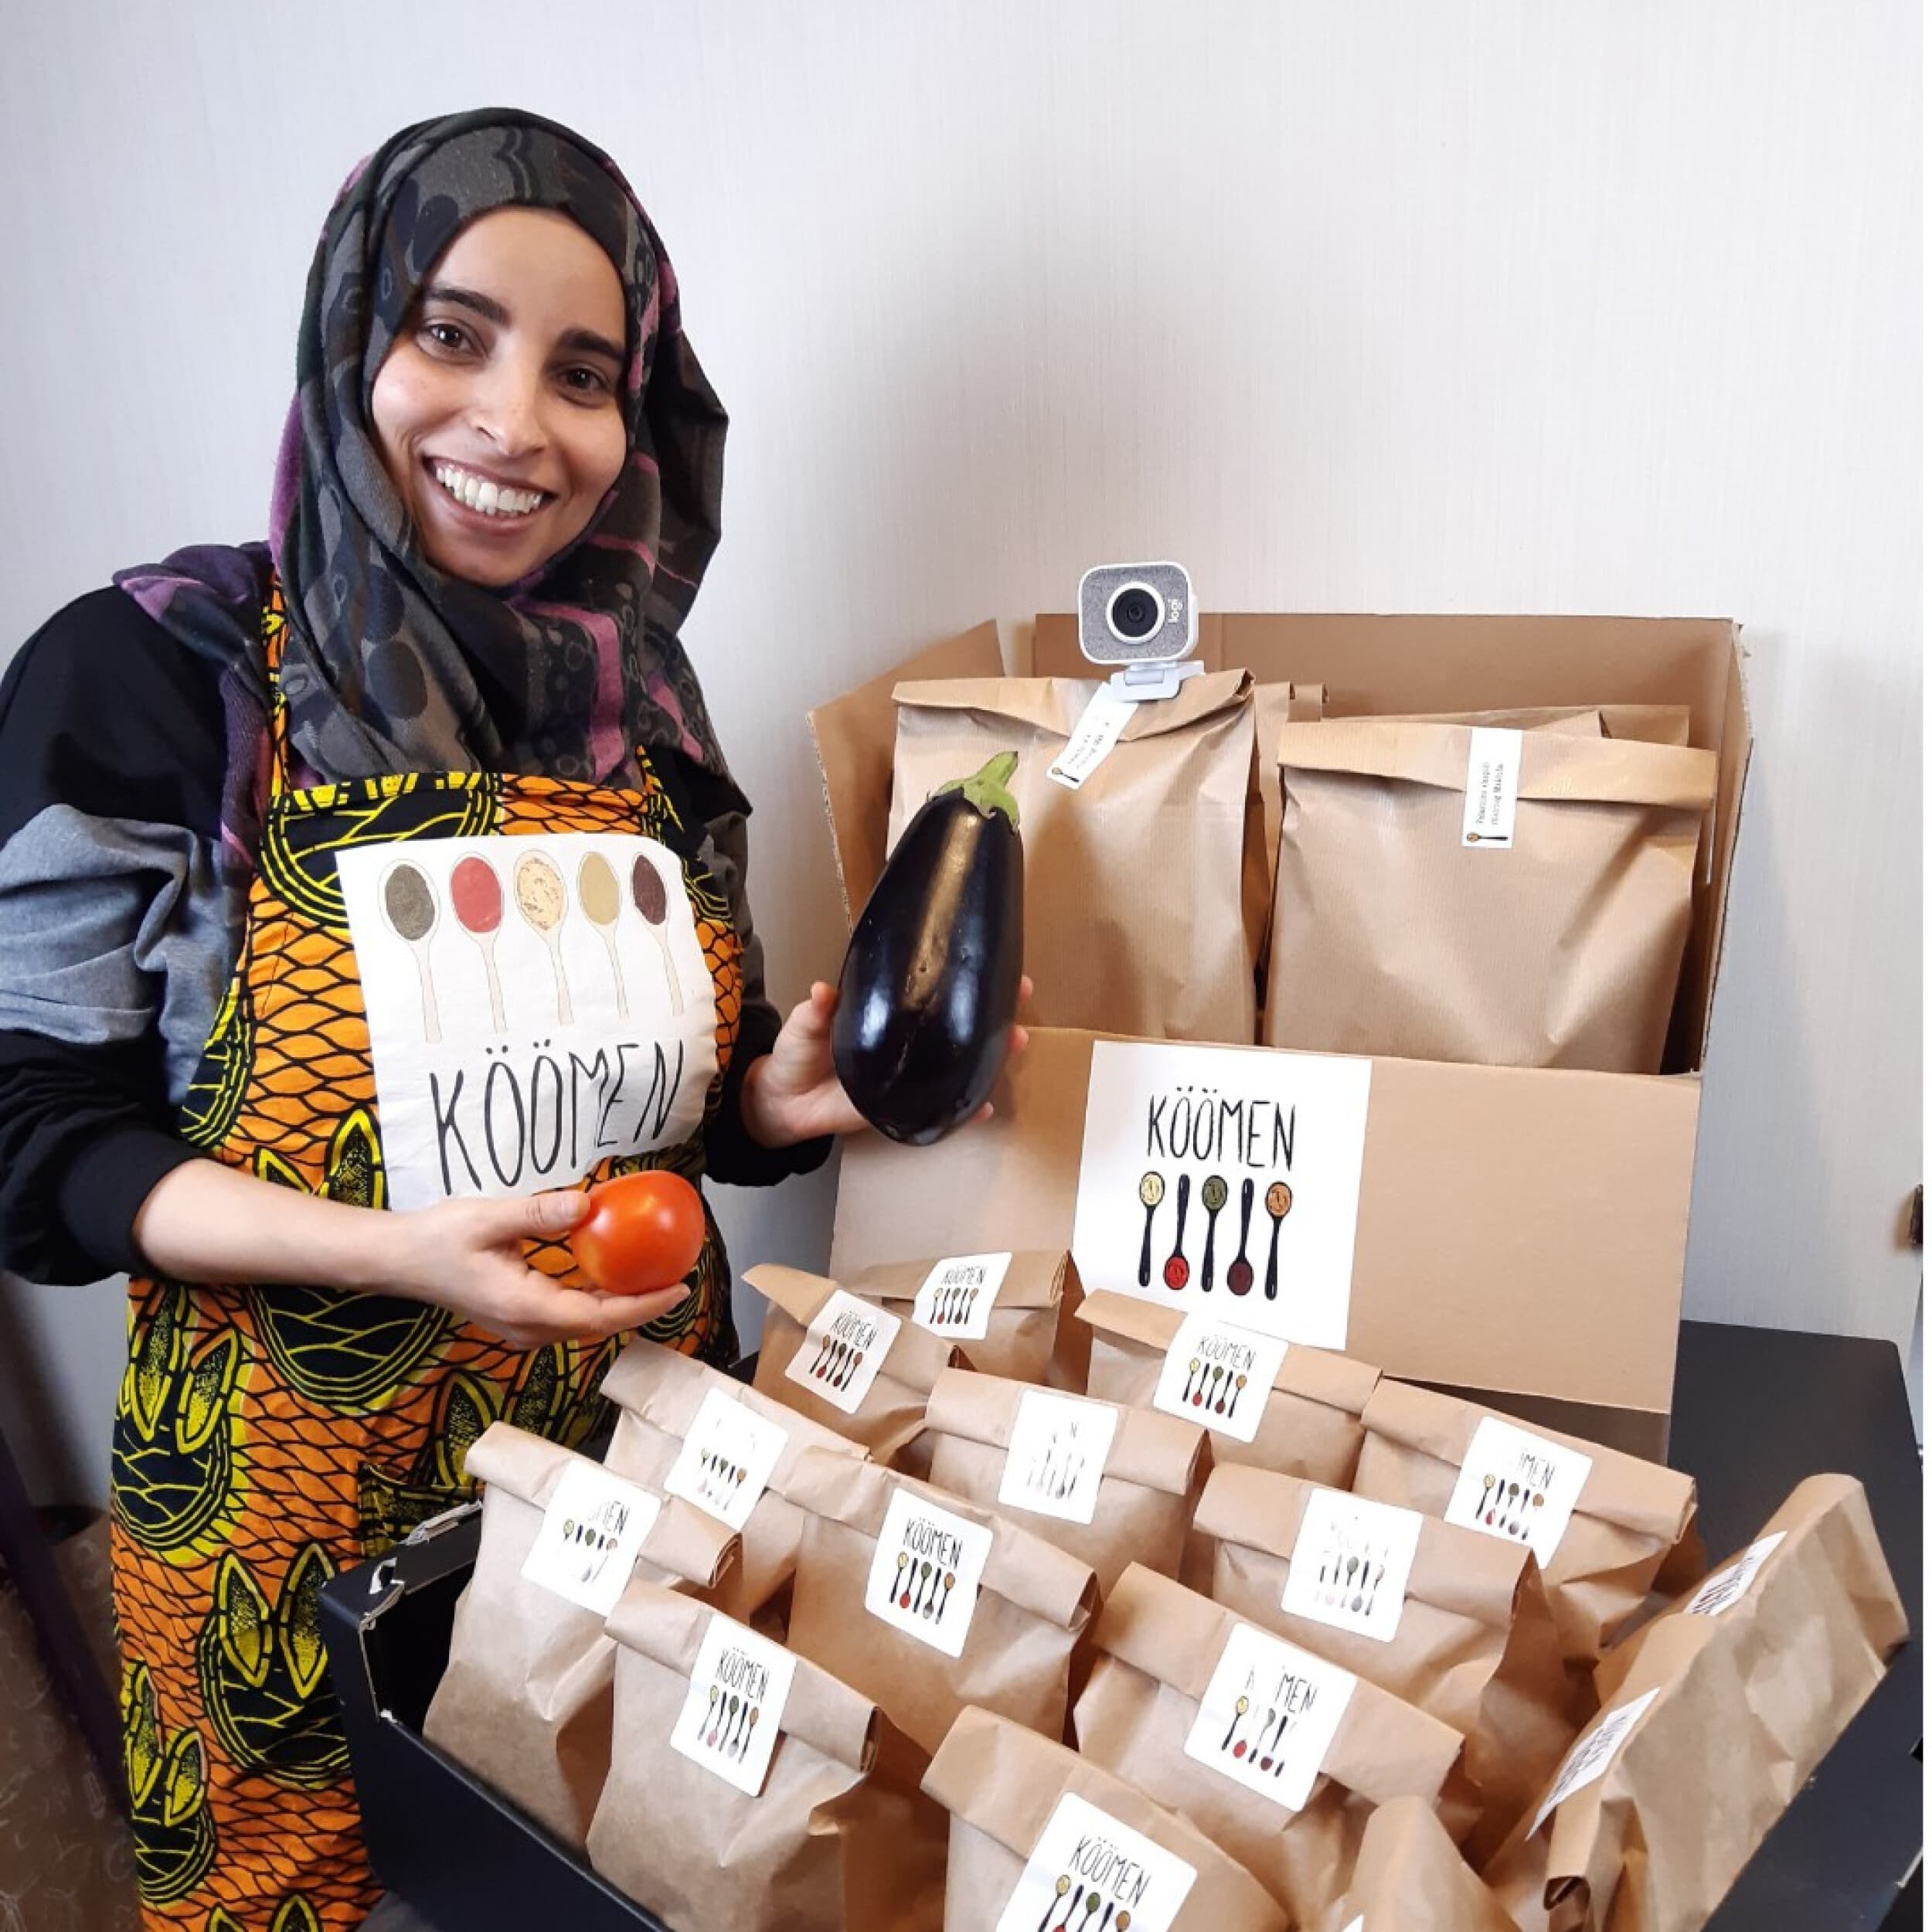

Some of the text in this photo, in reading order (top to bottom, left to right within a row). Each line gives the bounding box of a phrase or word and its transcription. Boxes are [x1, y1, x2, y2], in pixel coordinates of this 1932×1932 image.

[1168, 598, 1183, 624] logi
[429, 1039, 684, 1196] KÖÖMEN
[1148, 1085, 1296, 1172] KÖÖMEN
[940, 1264, 987, 1285] KÖÖMEN
[829, 1311, 879, 1351] KÖÖMEN
[1196, 1334, 1257, 1372] KÖÖMEN
[903, 1517, 963, 1571] KÖÖMEN
[716, 1647, 770, 1704] KÖÖMEN
[1068, 1835, 1152, 1909] KÖÖMEN
